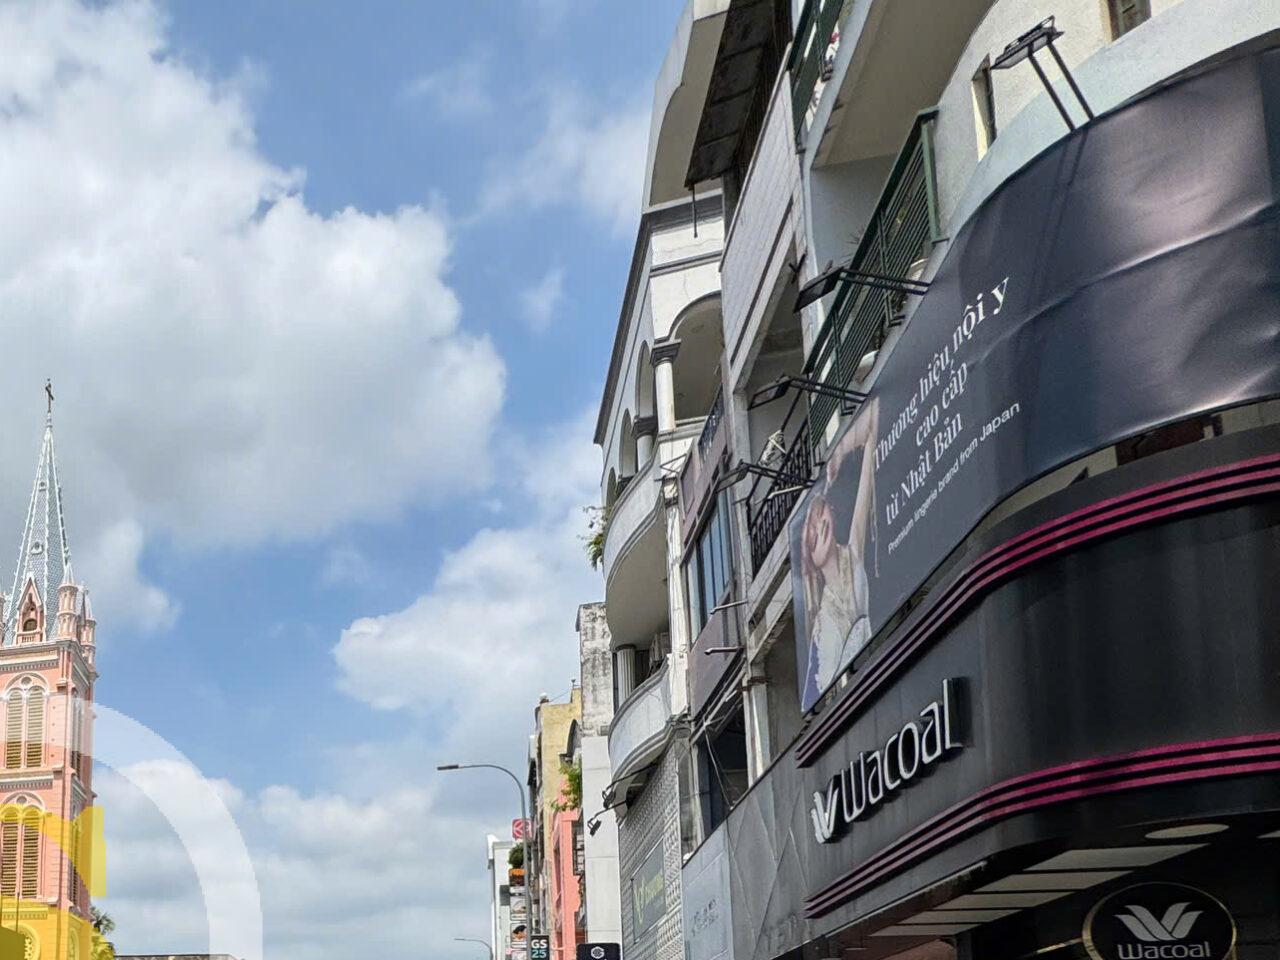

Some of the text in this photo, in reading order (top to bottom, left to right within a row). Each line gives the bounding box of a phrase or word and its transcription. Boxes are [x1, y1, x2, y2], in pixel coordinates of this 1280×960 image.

[919, 346, 951, 403] hiệu
[952, 293, 986, 354] nội
[991, 276, 1009, 315] y
[916, 358, 968, 447] cao cấp
[885, 412, 964, 526] từ Nhật Bản
[888, 518, 914, 555] Premium
[938, 459, 959, 492] brand
[959, 438, 978, 466] from
[979, 402, 1020, 442] Japan
[841, 678, 963, 824] Wacoal
[531, 939, 548, 949] GS
[531, 949, 547, 958] 25
[1116, 940, 1213, 960] Wacoal
